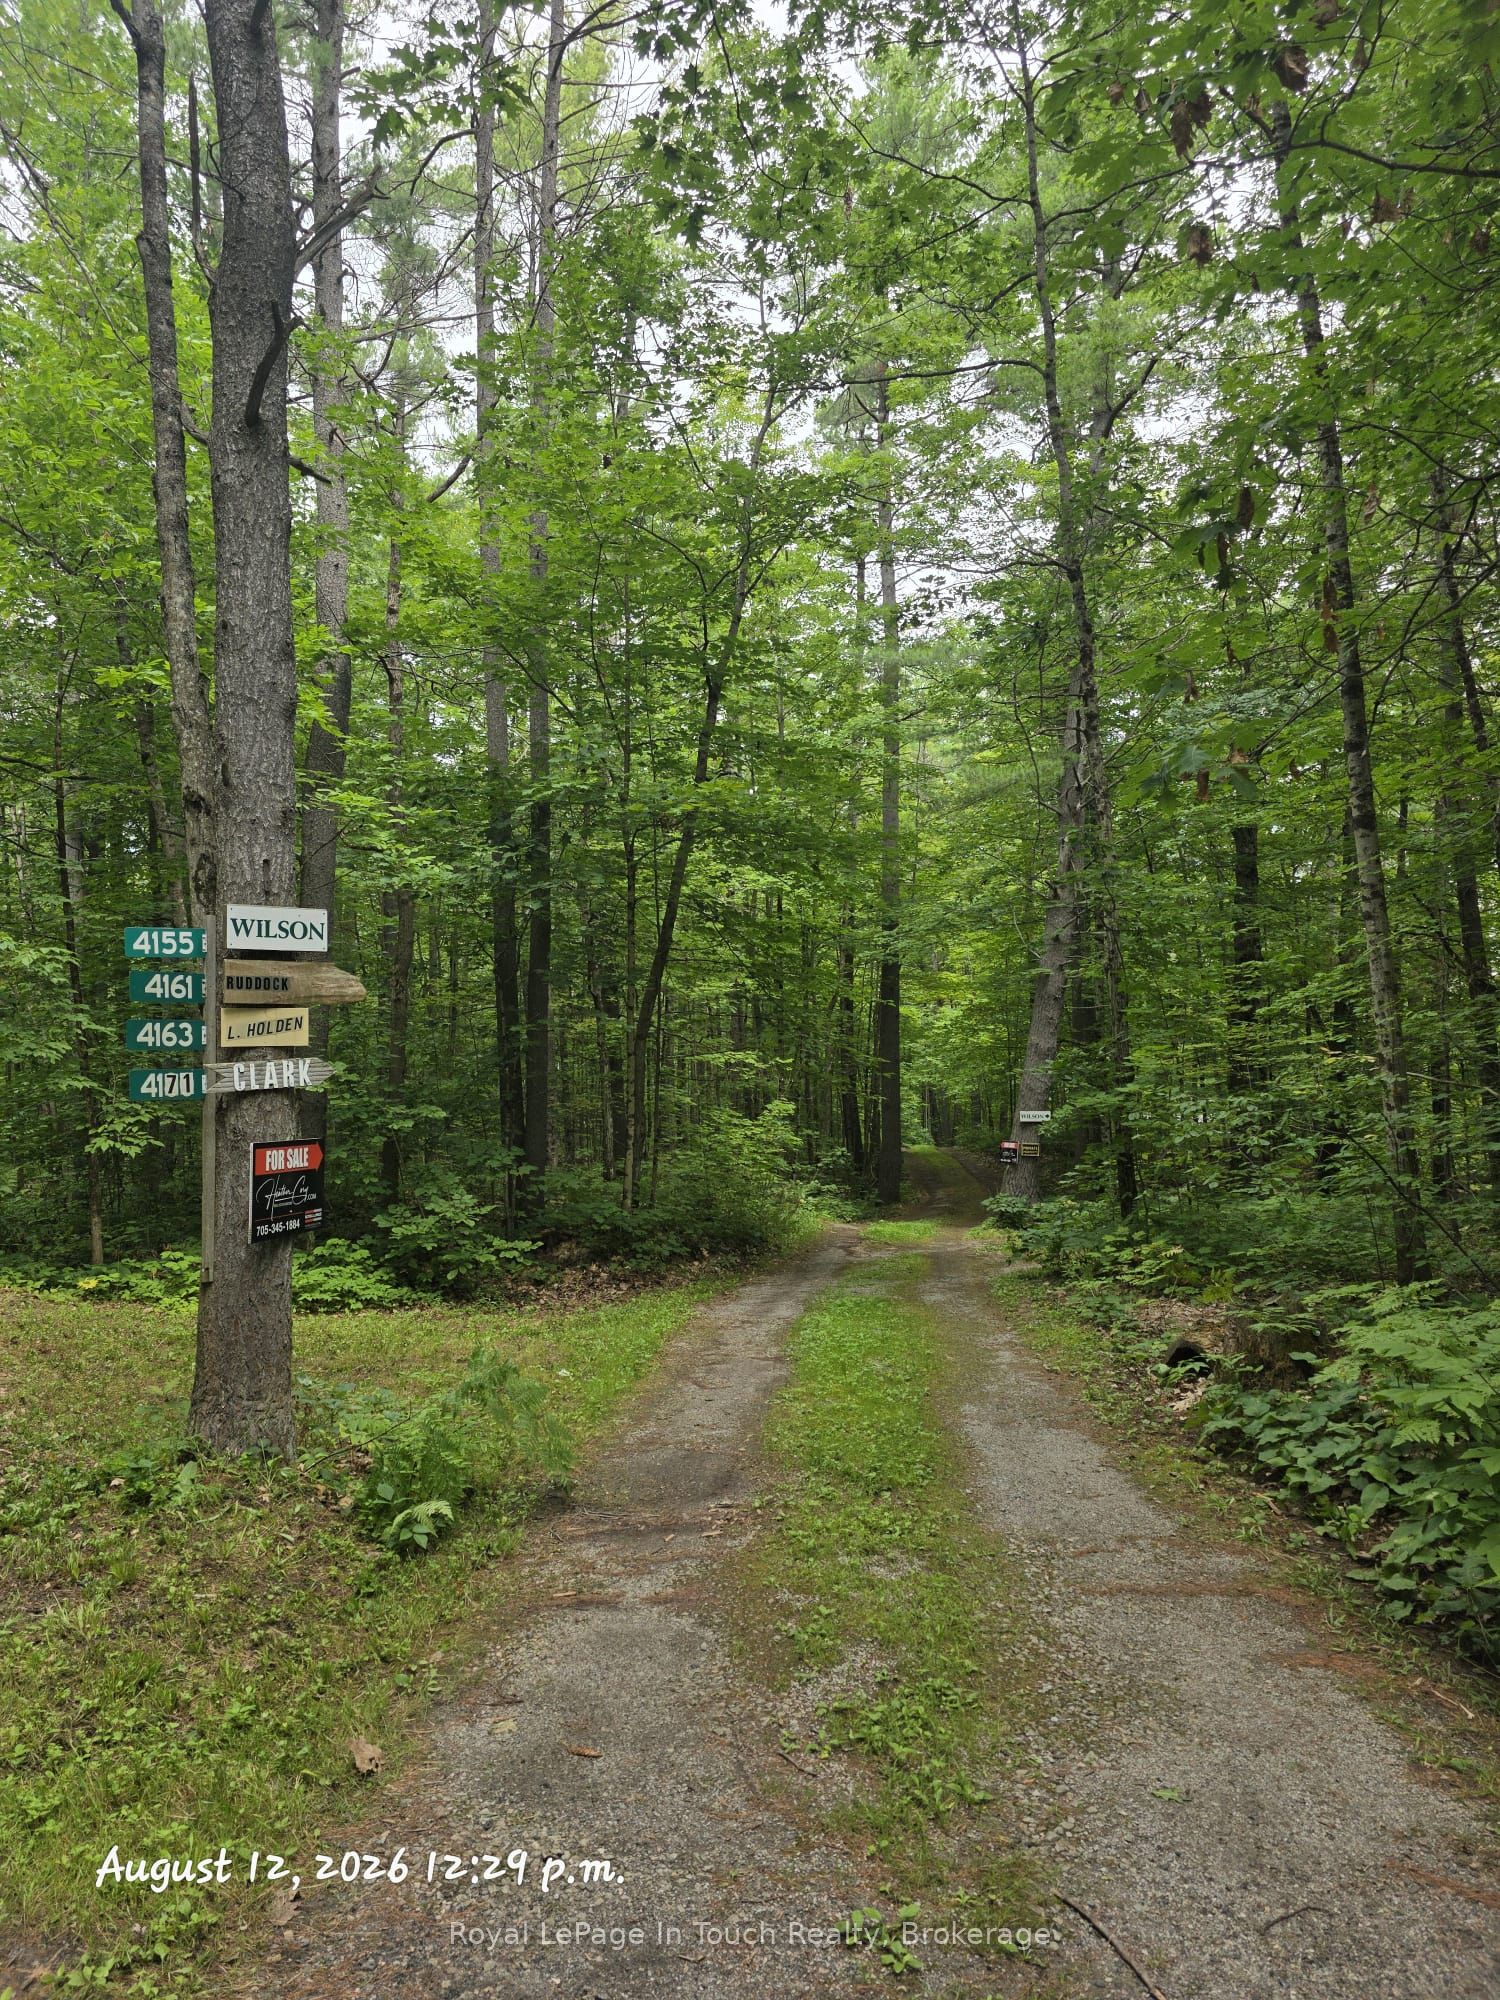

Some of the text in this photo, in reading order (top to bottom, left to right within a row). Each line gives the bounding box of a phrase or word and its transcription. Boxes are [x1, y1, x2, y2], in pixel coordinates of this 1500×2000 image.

[230, 918, 325, 941] WILSON
[132, 931, 194, 955] 4155
[144, 974, 193, 999] 4161
[226, 975, 289, 991] RUDDOCK
[136, 1022, 193, 1047] 4163
[227, 1016, 303, 1040] L. HOLDEN
[140, 1073, 194, 1098] 4171
[233, 1058, 313, 1091] CLARK
[265, 1147, 309, 1171] FOR SALE
[256, 1218, 300, 1237] 705-345-1884
